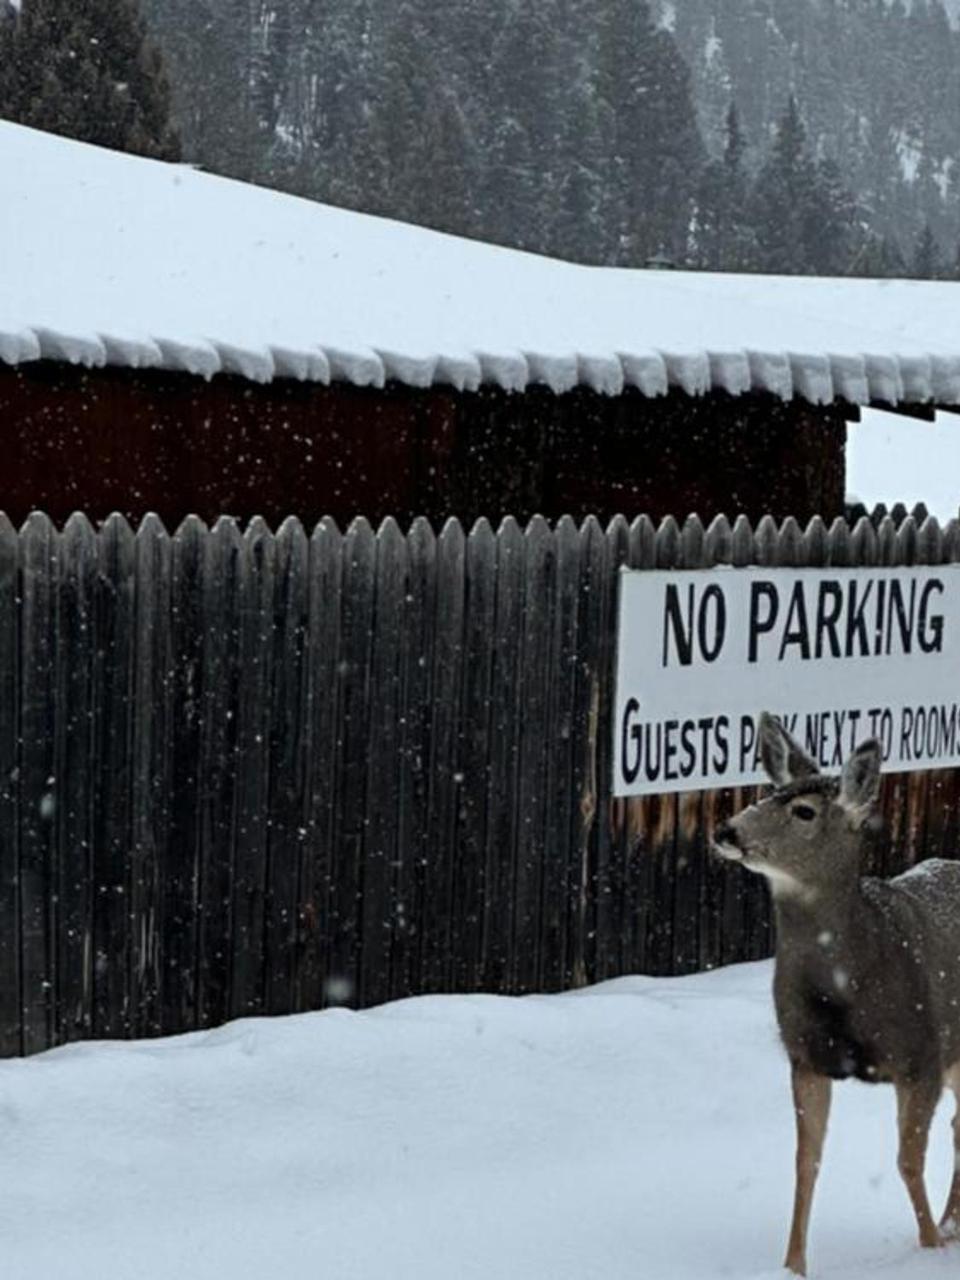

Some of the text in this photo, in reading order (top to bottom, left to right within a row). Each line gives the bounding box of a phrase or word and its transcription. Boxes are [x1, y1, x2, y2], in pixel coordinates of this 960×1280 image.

[663, 578, 944, 668] NO PARKING
[621, 697, 729, 785] GUESTS
[805, 709, 861, 768] NEXT
